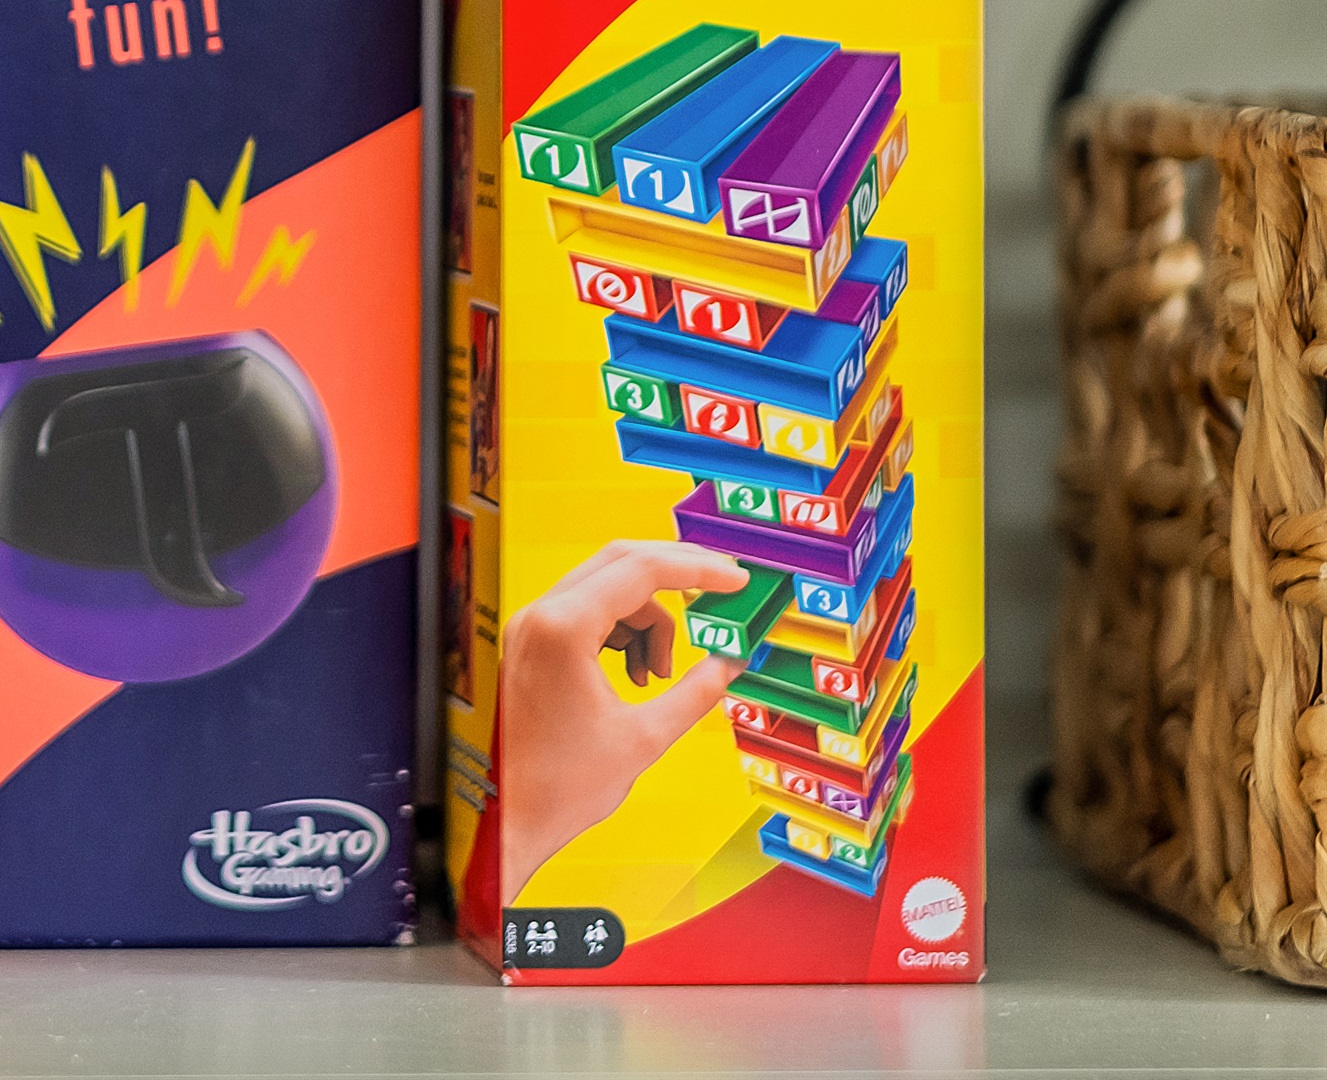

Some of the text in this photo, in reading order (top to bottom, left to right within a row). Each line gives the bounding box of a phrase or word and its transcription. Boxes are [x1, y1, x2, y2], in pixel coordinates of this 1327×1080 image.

[545, 144, 560, 176] 1
[649, 169, 663, 201] 1
[708, 301, 722, 331] 1
[626, 382, 643, 408] 3
[785, 425, 804, 451] 4
[738, 487, 755, 512] 3
[817, 589, 831, 611] 3
[832, 671, 845, 693] 3
[736, 704, 750, 722] 2
[189, 809, 374, 868] Hasbro
[221, 850, 345, 904] Gaming
[903, 895, 965, 923] MATTEL
[527, 940, 556, 955] 2-10
[898, 947, 970, 969] Games
